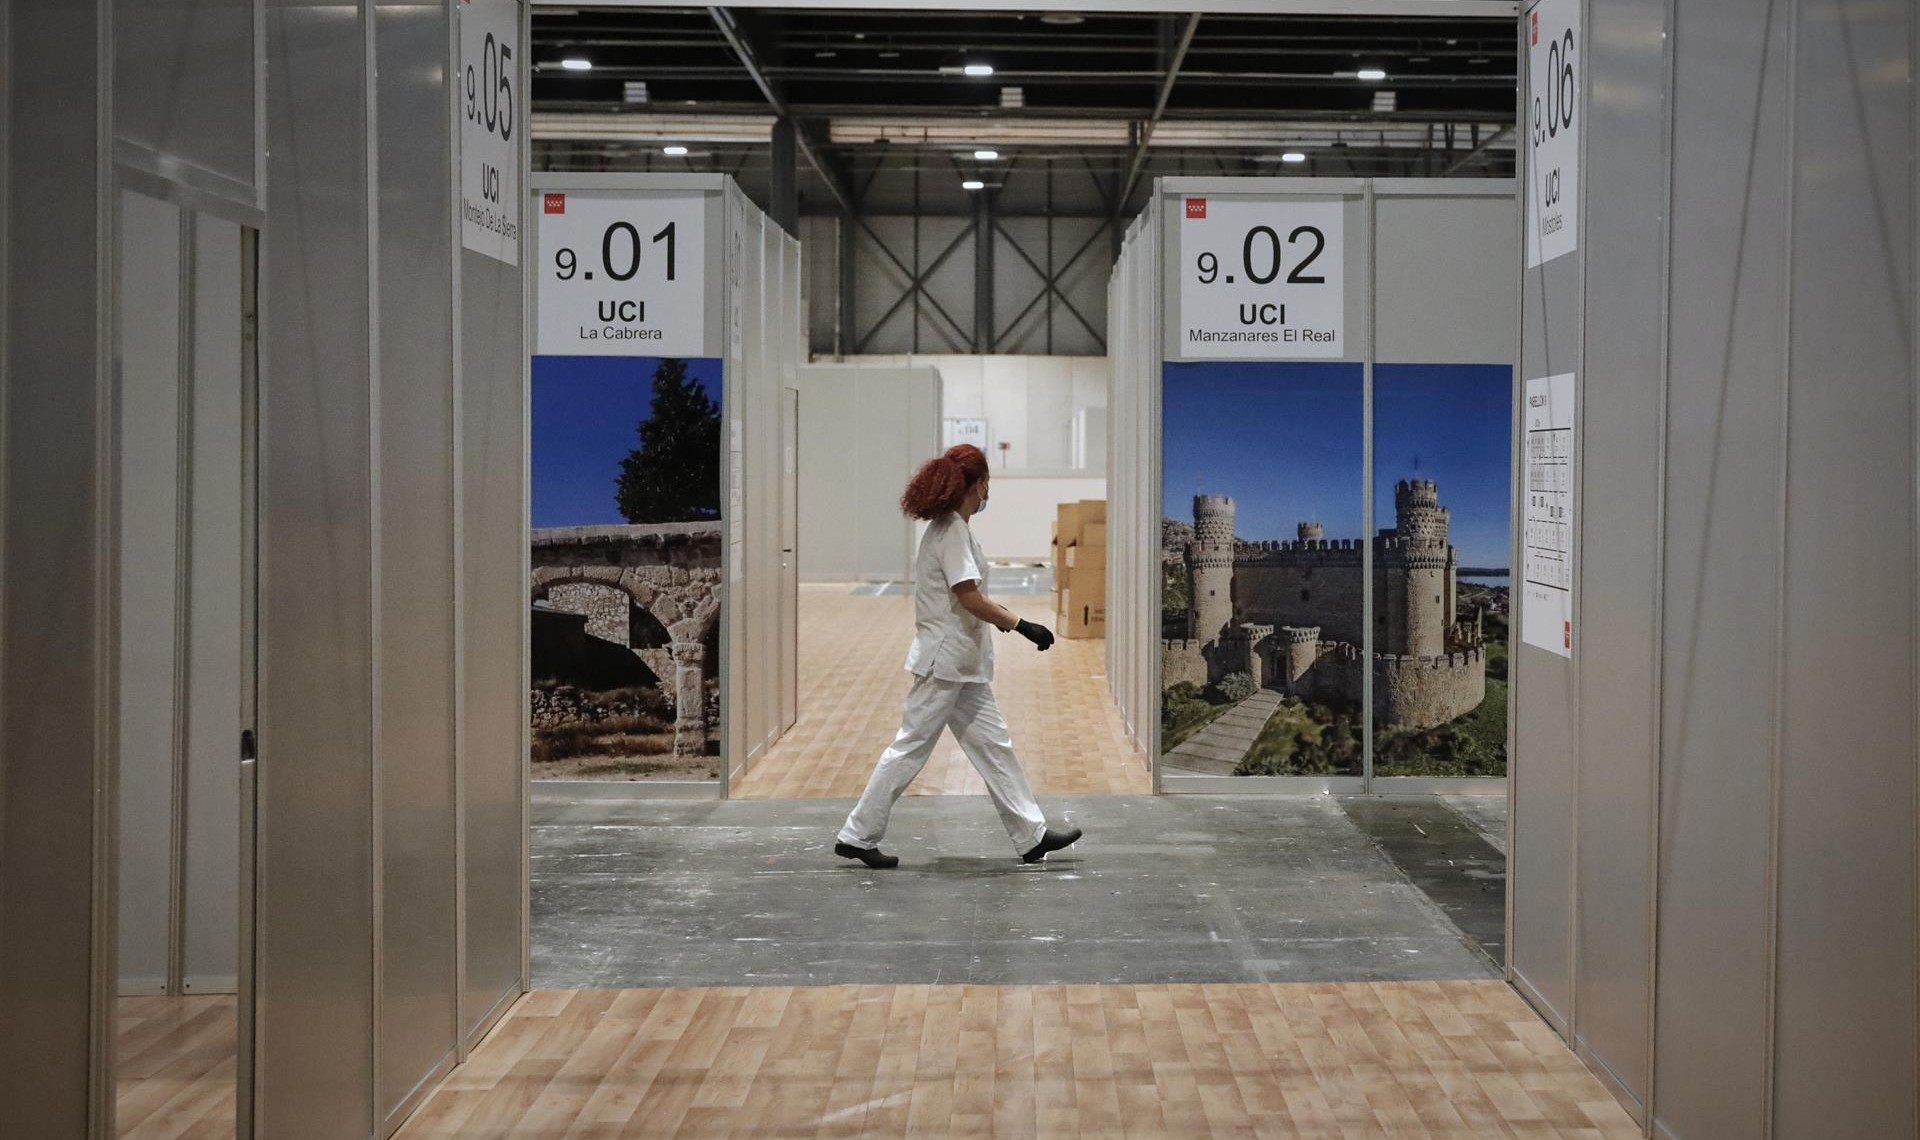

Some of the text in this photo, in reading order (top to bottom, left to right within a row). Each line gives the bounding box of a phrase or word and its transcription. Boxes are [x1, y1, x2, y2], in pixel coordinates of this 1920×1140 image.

[466, 31, 513, 142] 9.05
[1534, 27, 1574, 148] 9.06
[482, 162, 500, 205] UCI
[1545, 167, 1560, 207] UCI
[463, 197, 486, 232] Montejo
[485, 207, 494, 231] De
[494, 211, 501, 234] La
[555, 221, 676, 281] 9.01
[1197, 225, 1325, 284] 9.02
[598, 300, 645, 322] UCI
[1239, 303, 1285, 325] UCI
[580, 326, 662, 340] La Cabrera
[1189, 329, 1335, 342] Manzanares El Real
